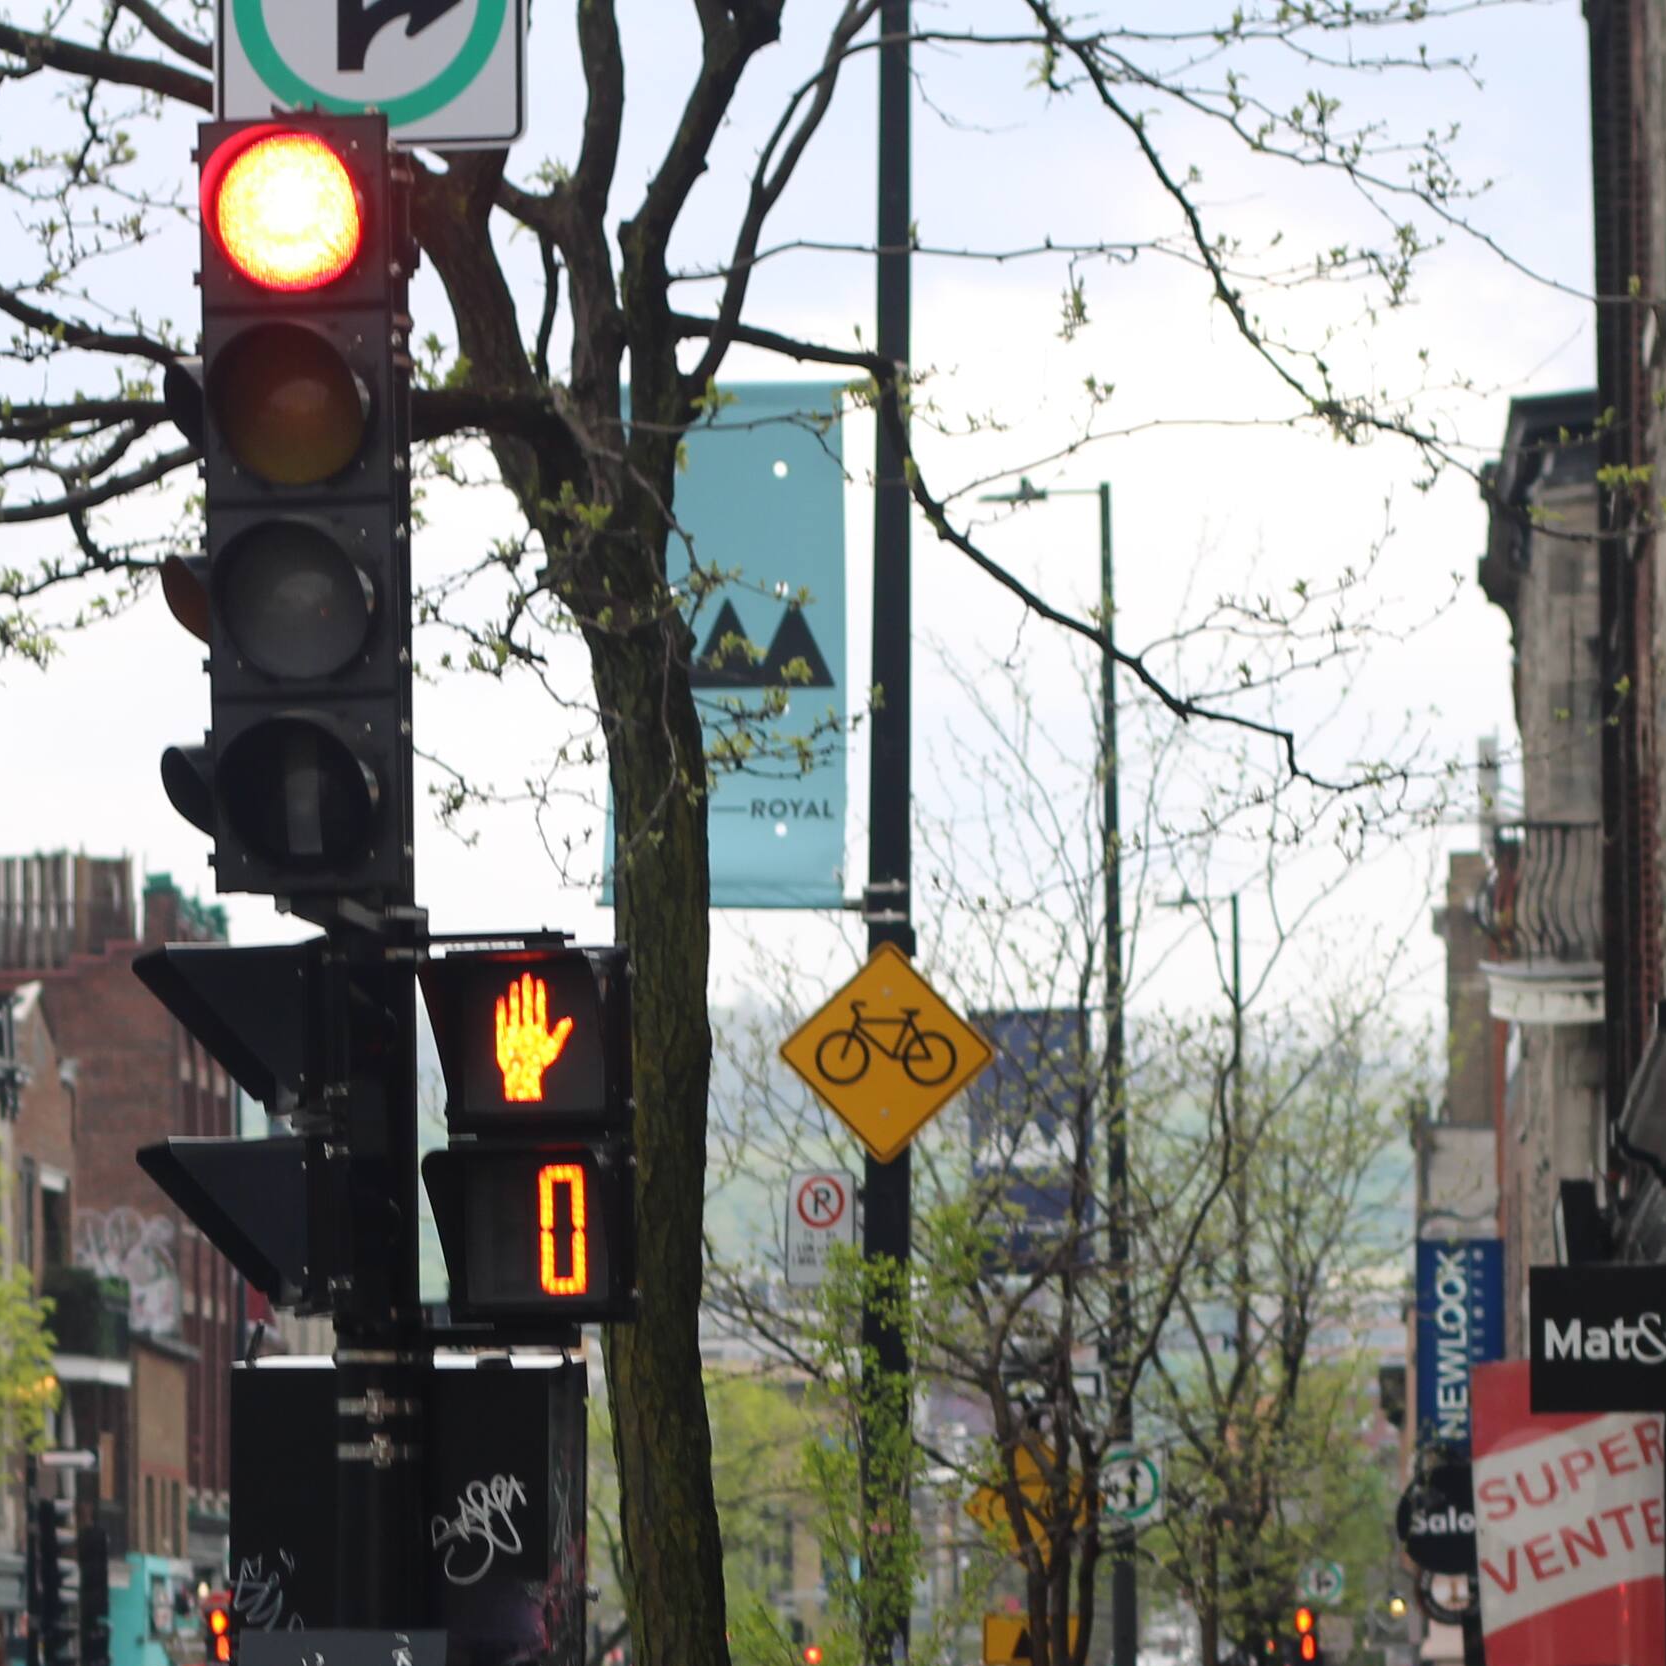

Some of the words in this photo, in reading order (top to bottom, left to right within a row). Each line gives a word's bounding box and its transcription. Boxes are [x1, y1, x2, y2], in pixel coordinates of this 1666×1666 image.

[539, 1164, 587, 1295] 0
[1477, 1418, 1665, 1522] SUPER
[1480, 1497, 1665, 1595] VENTE
